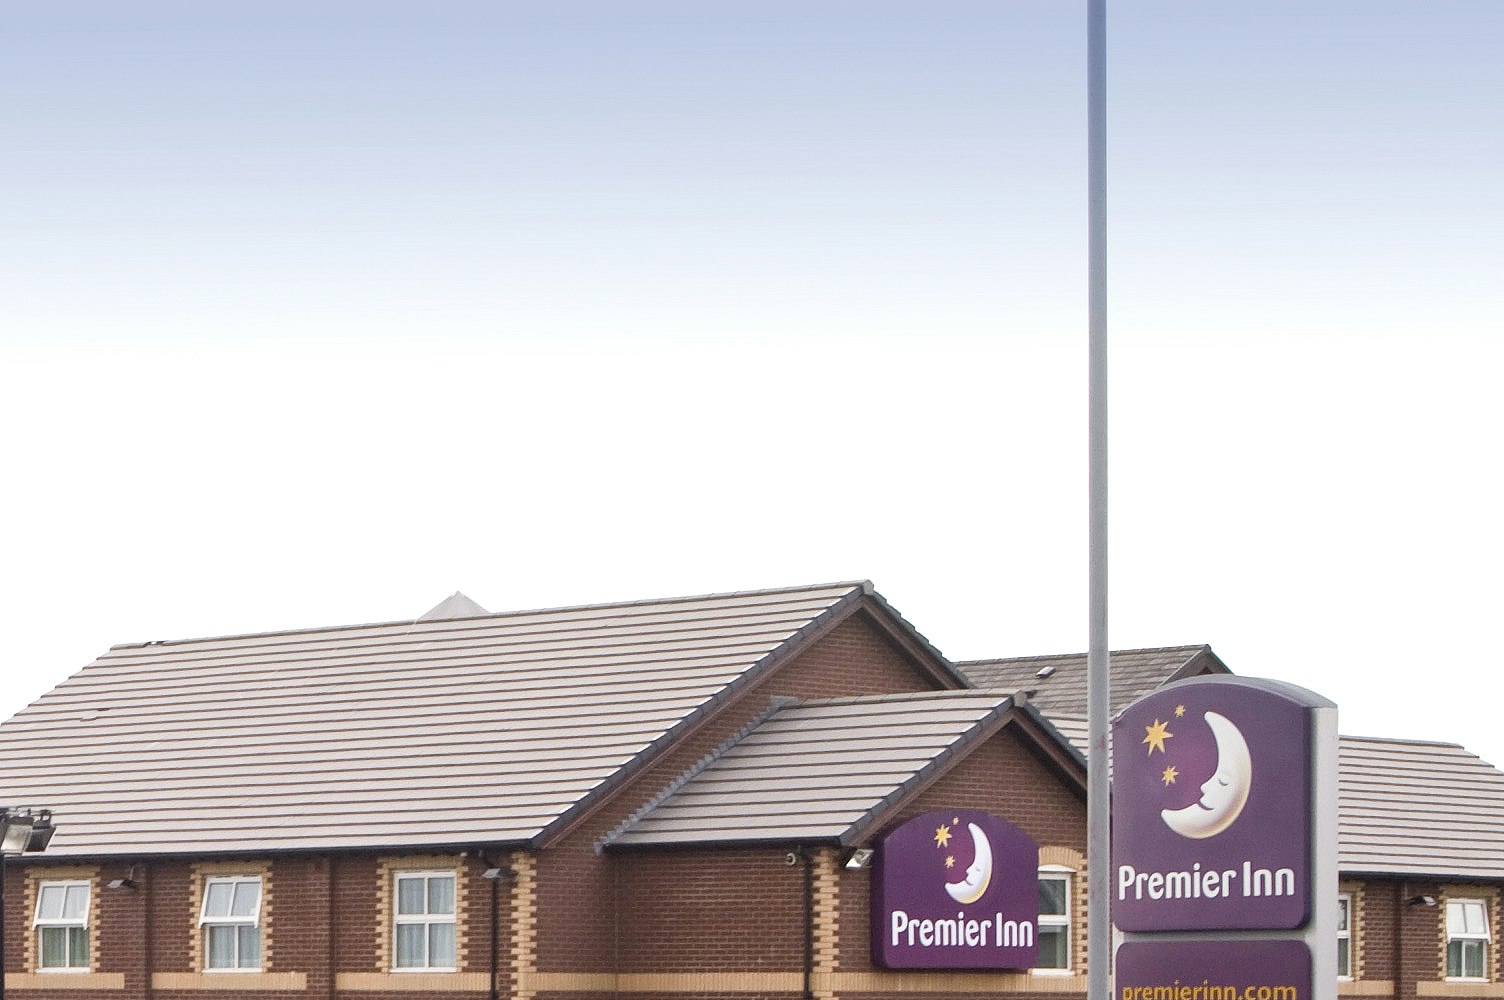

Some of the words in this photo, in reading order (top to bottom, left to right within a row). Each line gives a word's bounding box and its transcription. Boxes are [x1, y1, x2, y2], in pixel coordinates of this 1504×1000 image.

[1118, 862, 1237, 900] Premier
[1243, 861, 1295, 897] Inn
[891, 910, 992, 947] Premier
[996, 912, 1033, 947] Inn
